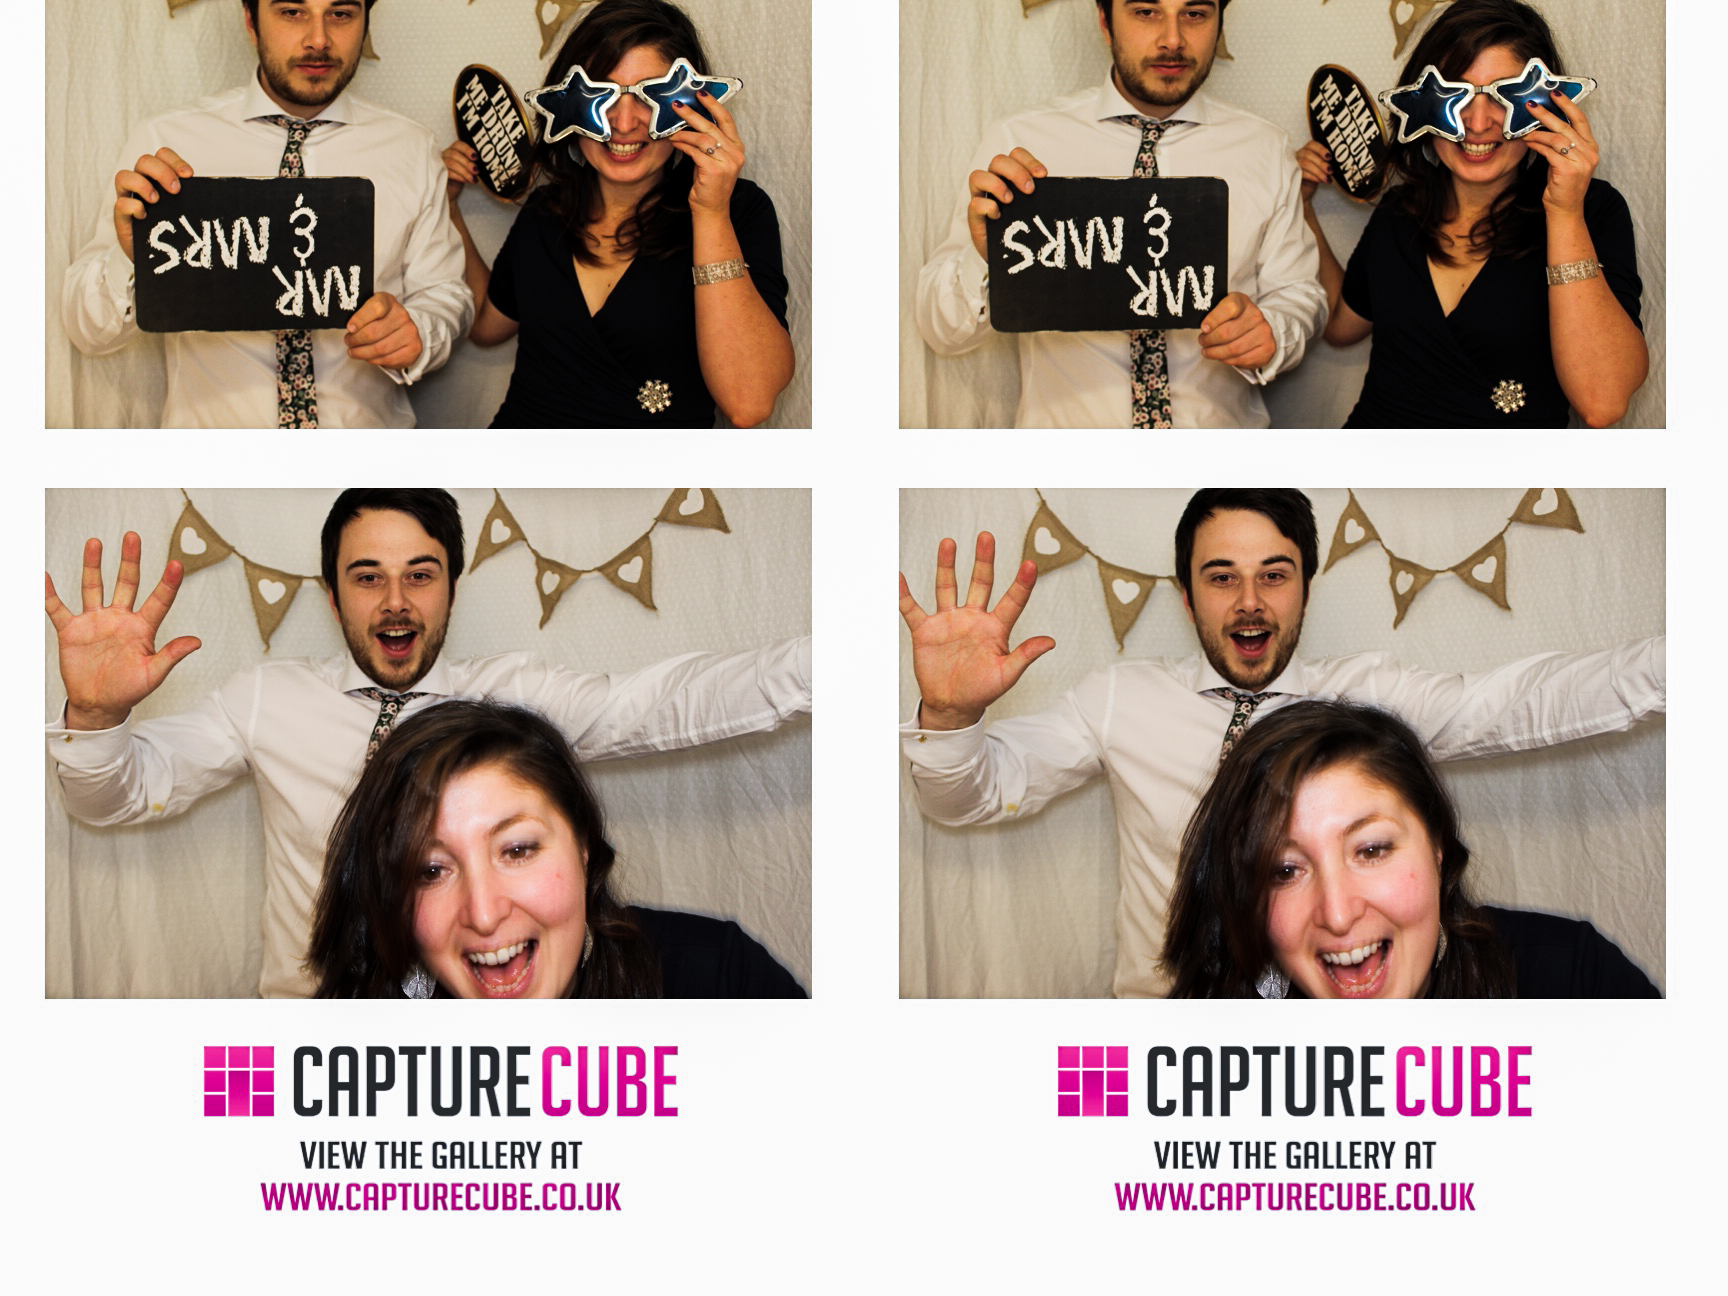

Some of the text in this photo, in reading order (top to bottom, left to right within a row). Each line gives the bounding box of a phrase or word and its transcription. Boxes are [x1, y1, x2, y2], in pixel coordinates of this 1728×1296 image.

[456, 92, 510, 192] I'M HOME
[465, 74, 523, 185] ME DRUNK
[491, 84, 526, 145] TAKE
[1310, 92, 1364, 192] I'M HOME
[1319, 74, 1377, 185] ME DRUNK
[1345, 84, 1380, 145] TAKE
[272, 265, 361, 317] MR
[1126, 265, 1215, 317] MR
